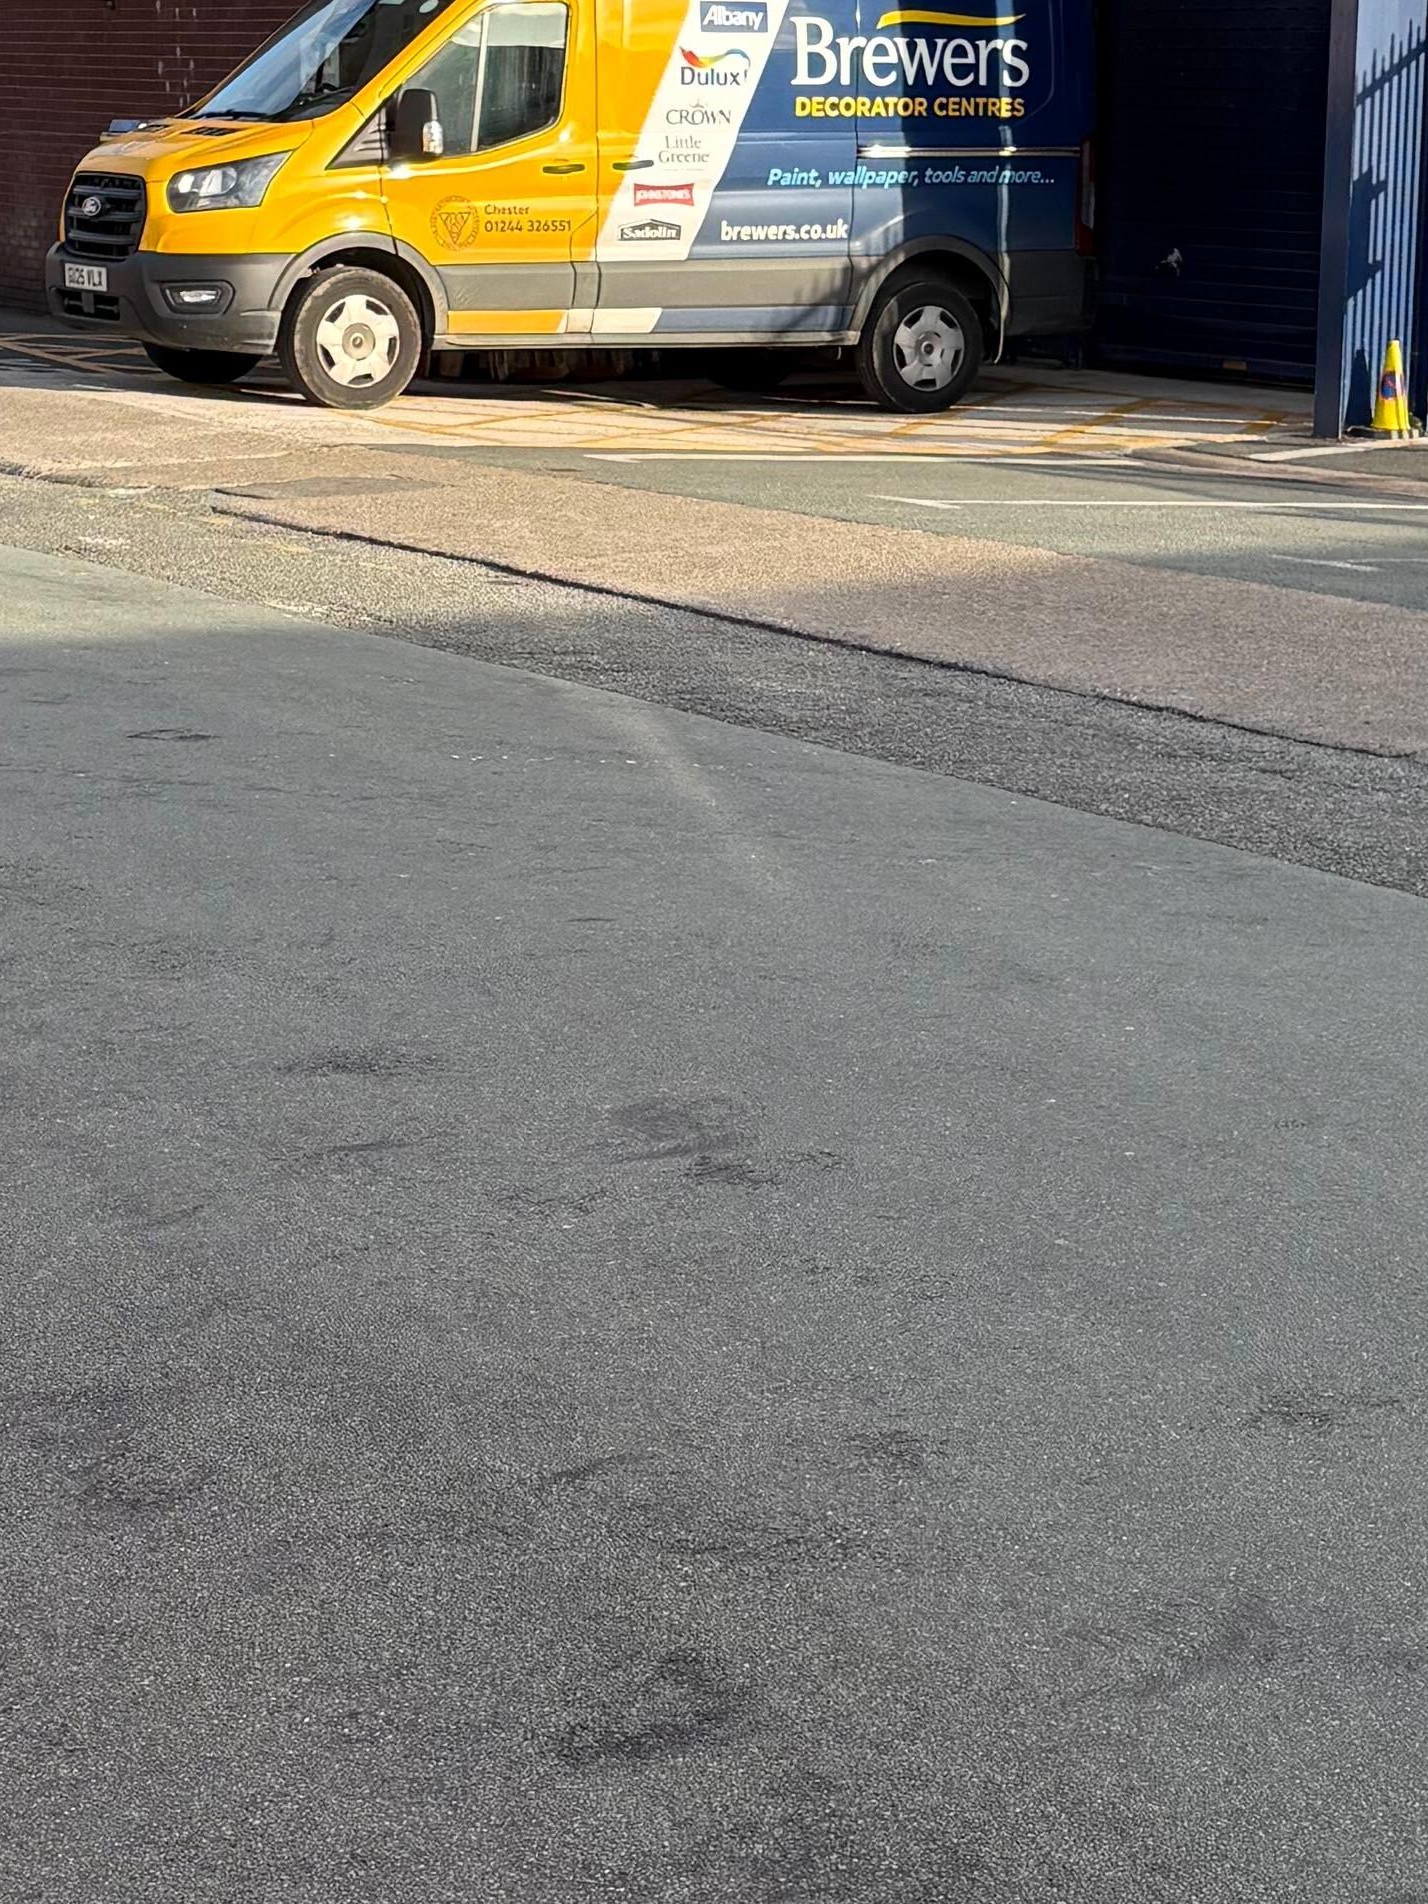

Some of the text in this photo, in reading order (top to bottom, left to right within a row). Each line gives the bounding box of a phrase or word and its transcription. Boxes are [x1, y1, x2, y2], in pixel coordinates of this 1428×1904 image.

[703, 4, 764, 31] Albany
[789, 16, 1030, 88] Brewers
[680, 66, 741, 86] Dulux
[666, 108, 731, 125] CROWN
[795, 96, 1025, 119] DECORATOR CENTRES
[665, 135, 702, 149] Little
[658, 150, 710, 163] Greene
[767, 166, 1055, 189] Paint, wallpaper, tools and more...
[484, 204, 530, 215] Chester
[484, 219, 571, 232] 01244 326551
[622, 226, 678, 239] Sadolin
[721, 218, 849, 241] brewers.co.uk
